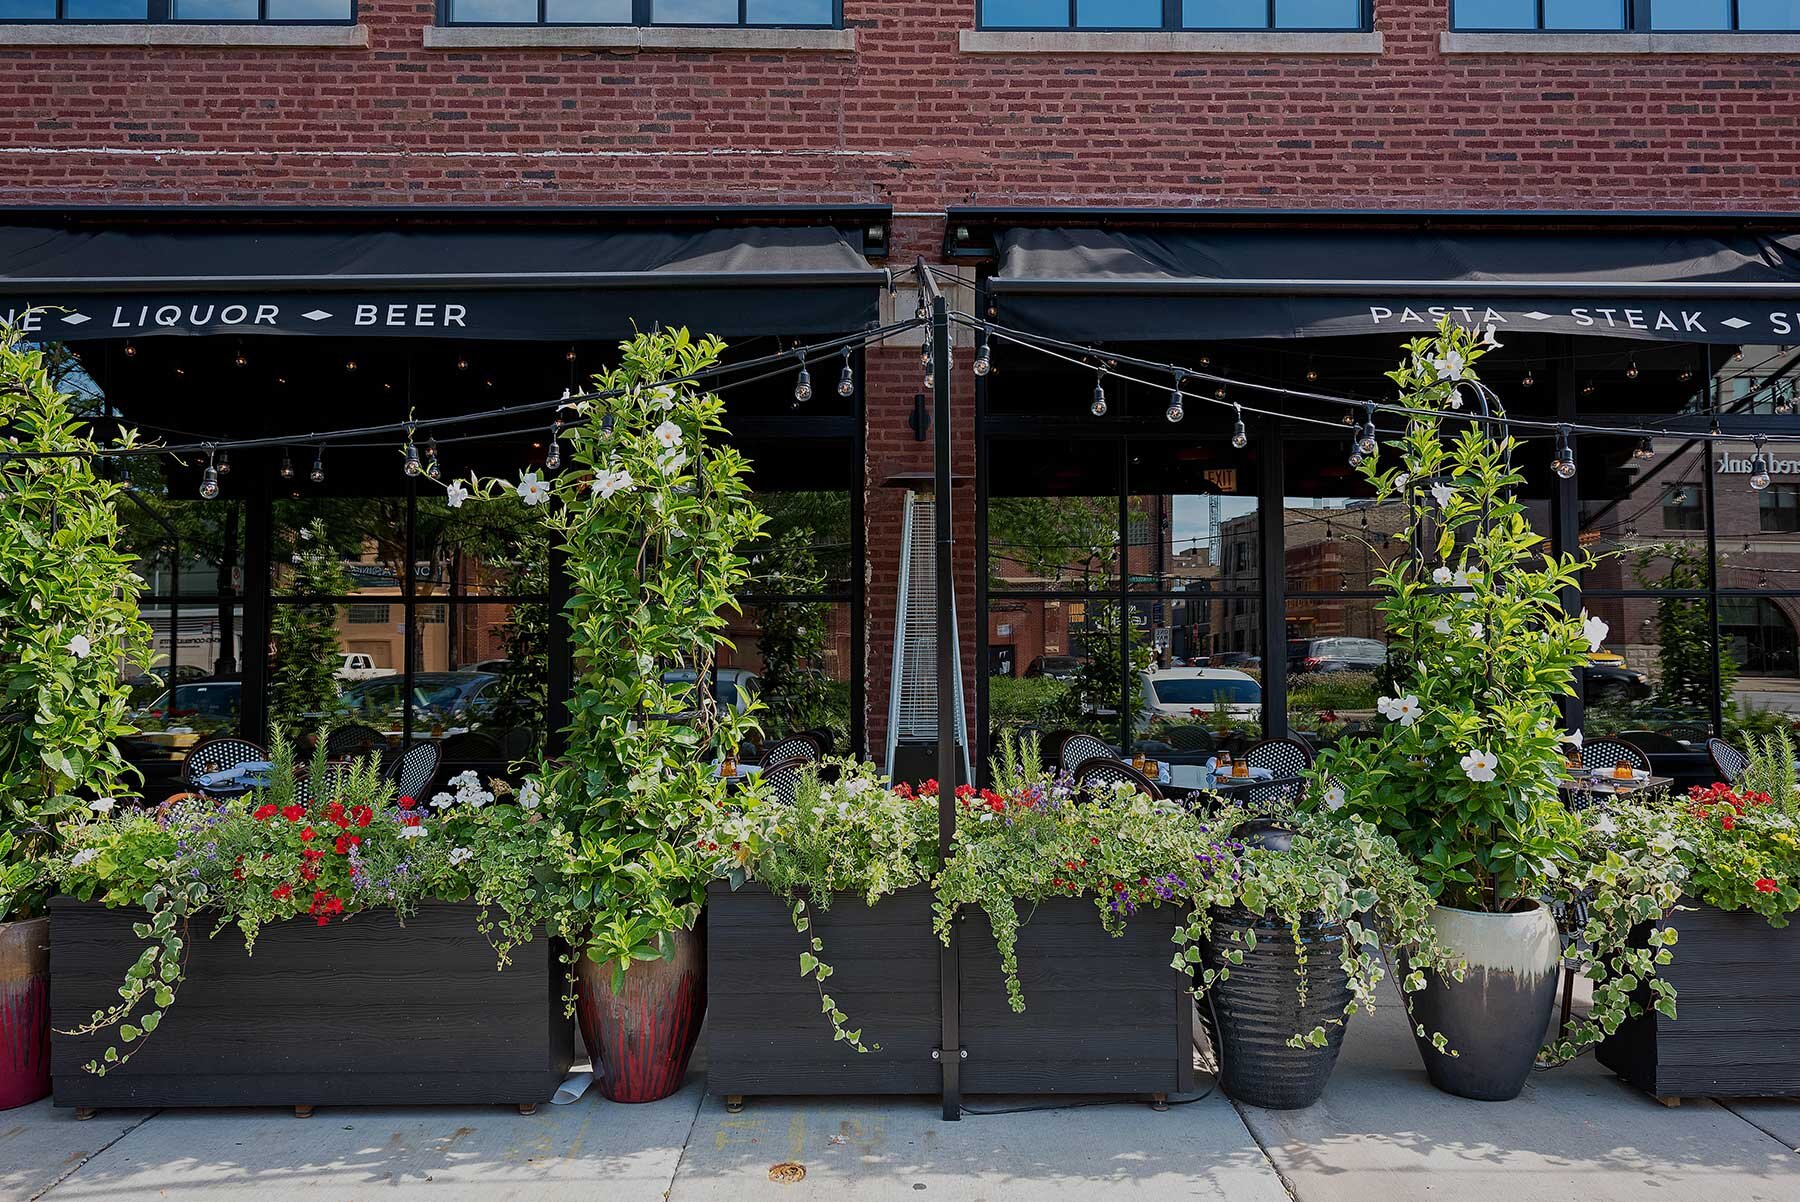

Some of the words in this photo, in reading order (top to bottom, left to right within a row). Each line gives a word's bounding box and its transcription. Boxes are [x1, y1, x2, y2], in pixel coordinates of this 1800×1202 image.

[112, 304, 279, 327] LIQUOR
[353, 304, 466, 327] BEER
[1370, 306, 1507, 324] PASTA
[1570, 307, 1708, 333] STEAK
[1770, 312, 1800, 334] S
[1208, 470, 1232, 486] EXIT
